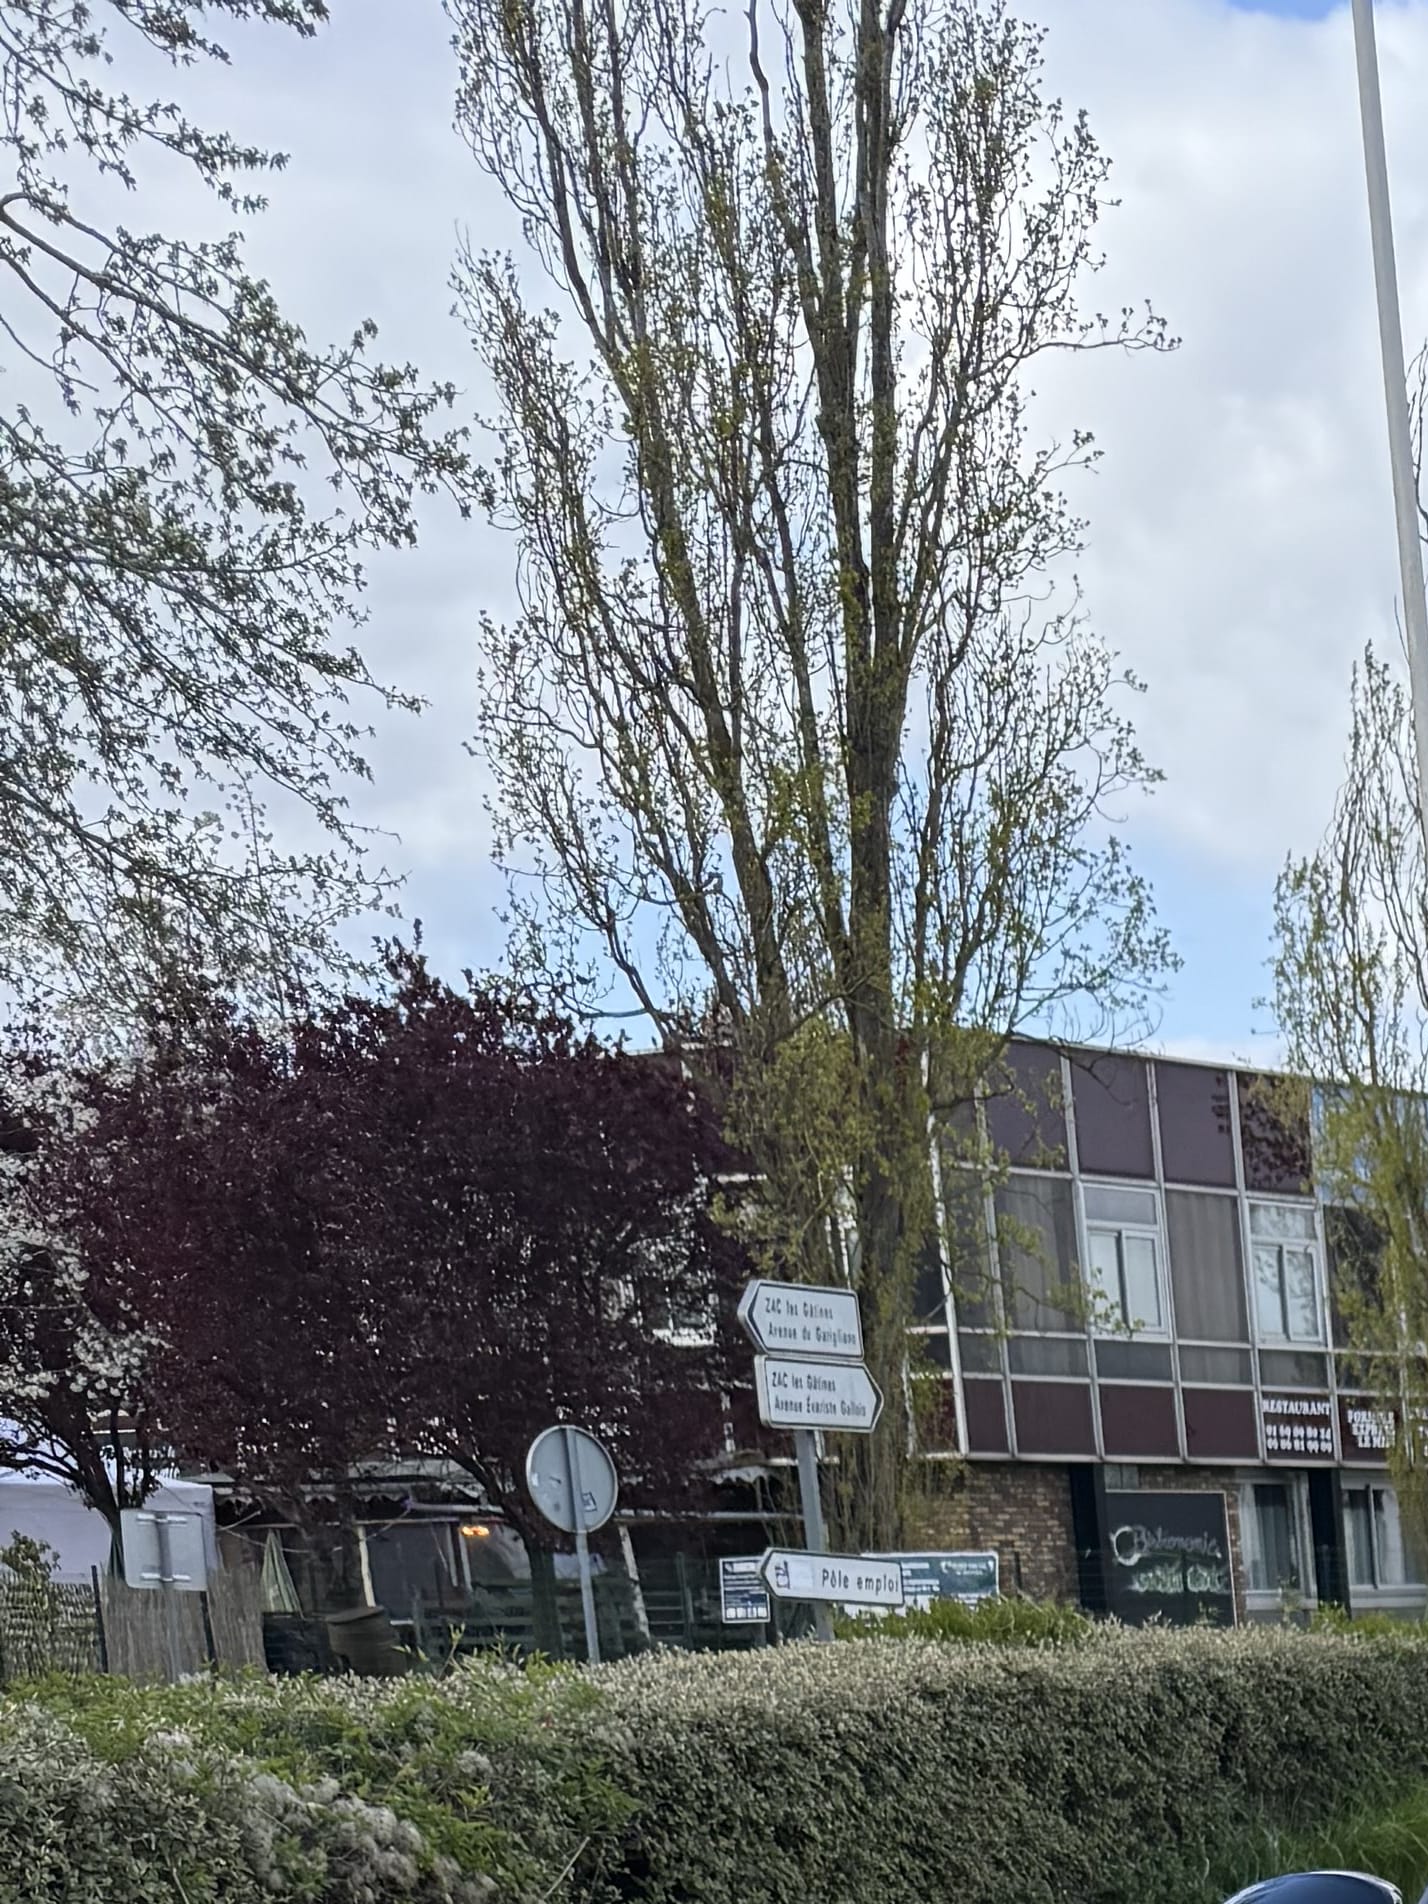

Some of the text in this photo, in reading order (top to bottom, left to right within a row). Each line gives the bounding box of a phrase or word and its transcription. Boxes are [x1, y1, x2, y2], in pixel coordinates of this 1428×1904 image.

[765, 1297, 781, 1315] ZAC
[786, 1301, 798, 1317] les
[768, 1322, 797, 1341] Avenue
[772, 1371, 788, 1389] ZAC
[792, 1374, 803, 1389] les
[774, 1396, 803, 1413] Avenue
[1263, 1400, 1331, 1416] RESTAURANT
[822, 1567, 849, 1590] Pôle
[857, 1575, 900, 1596] emploi
